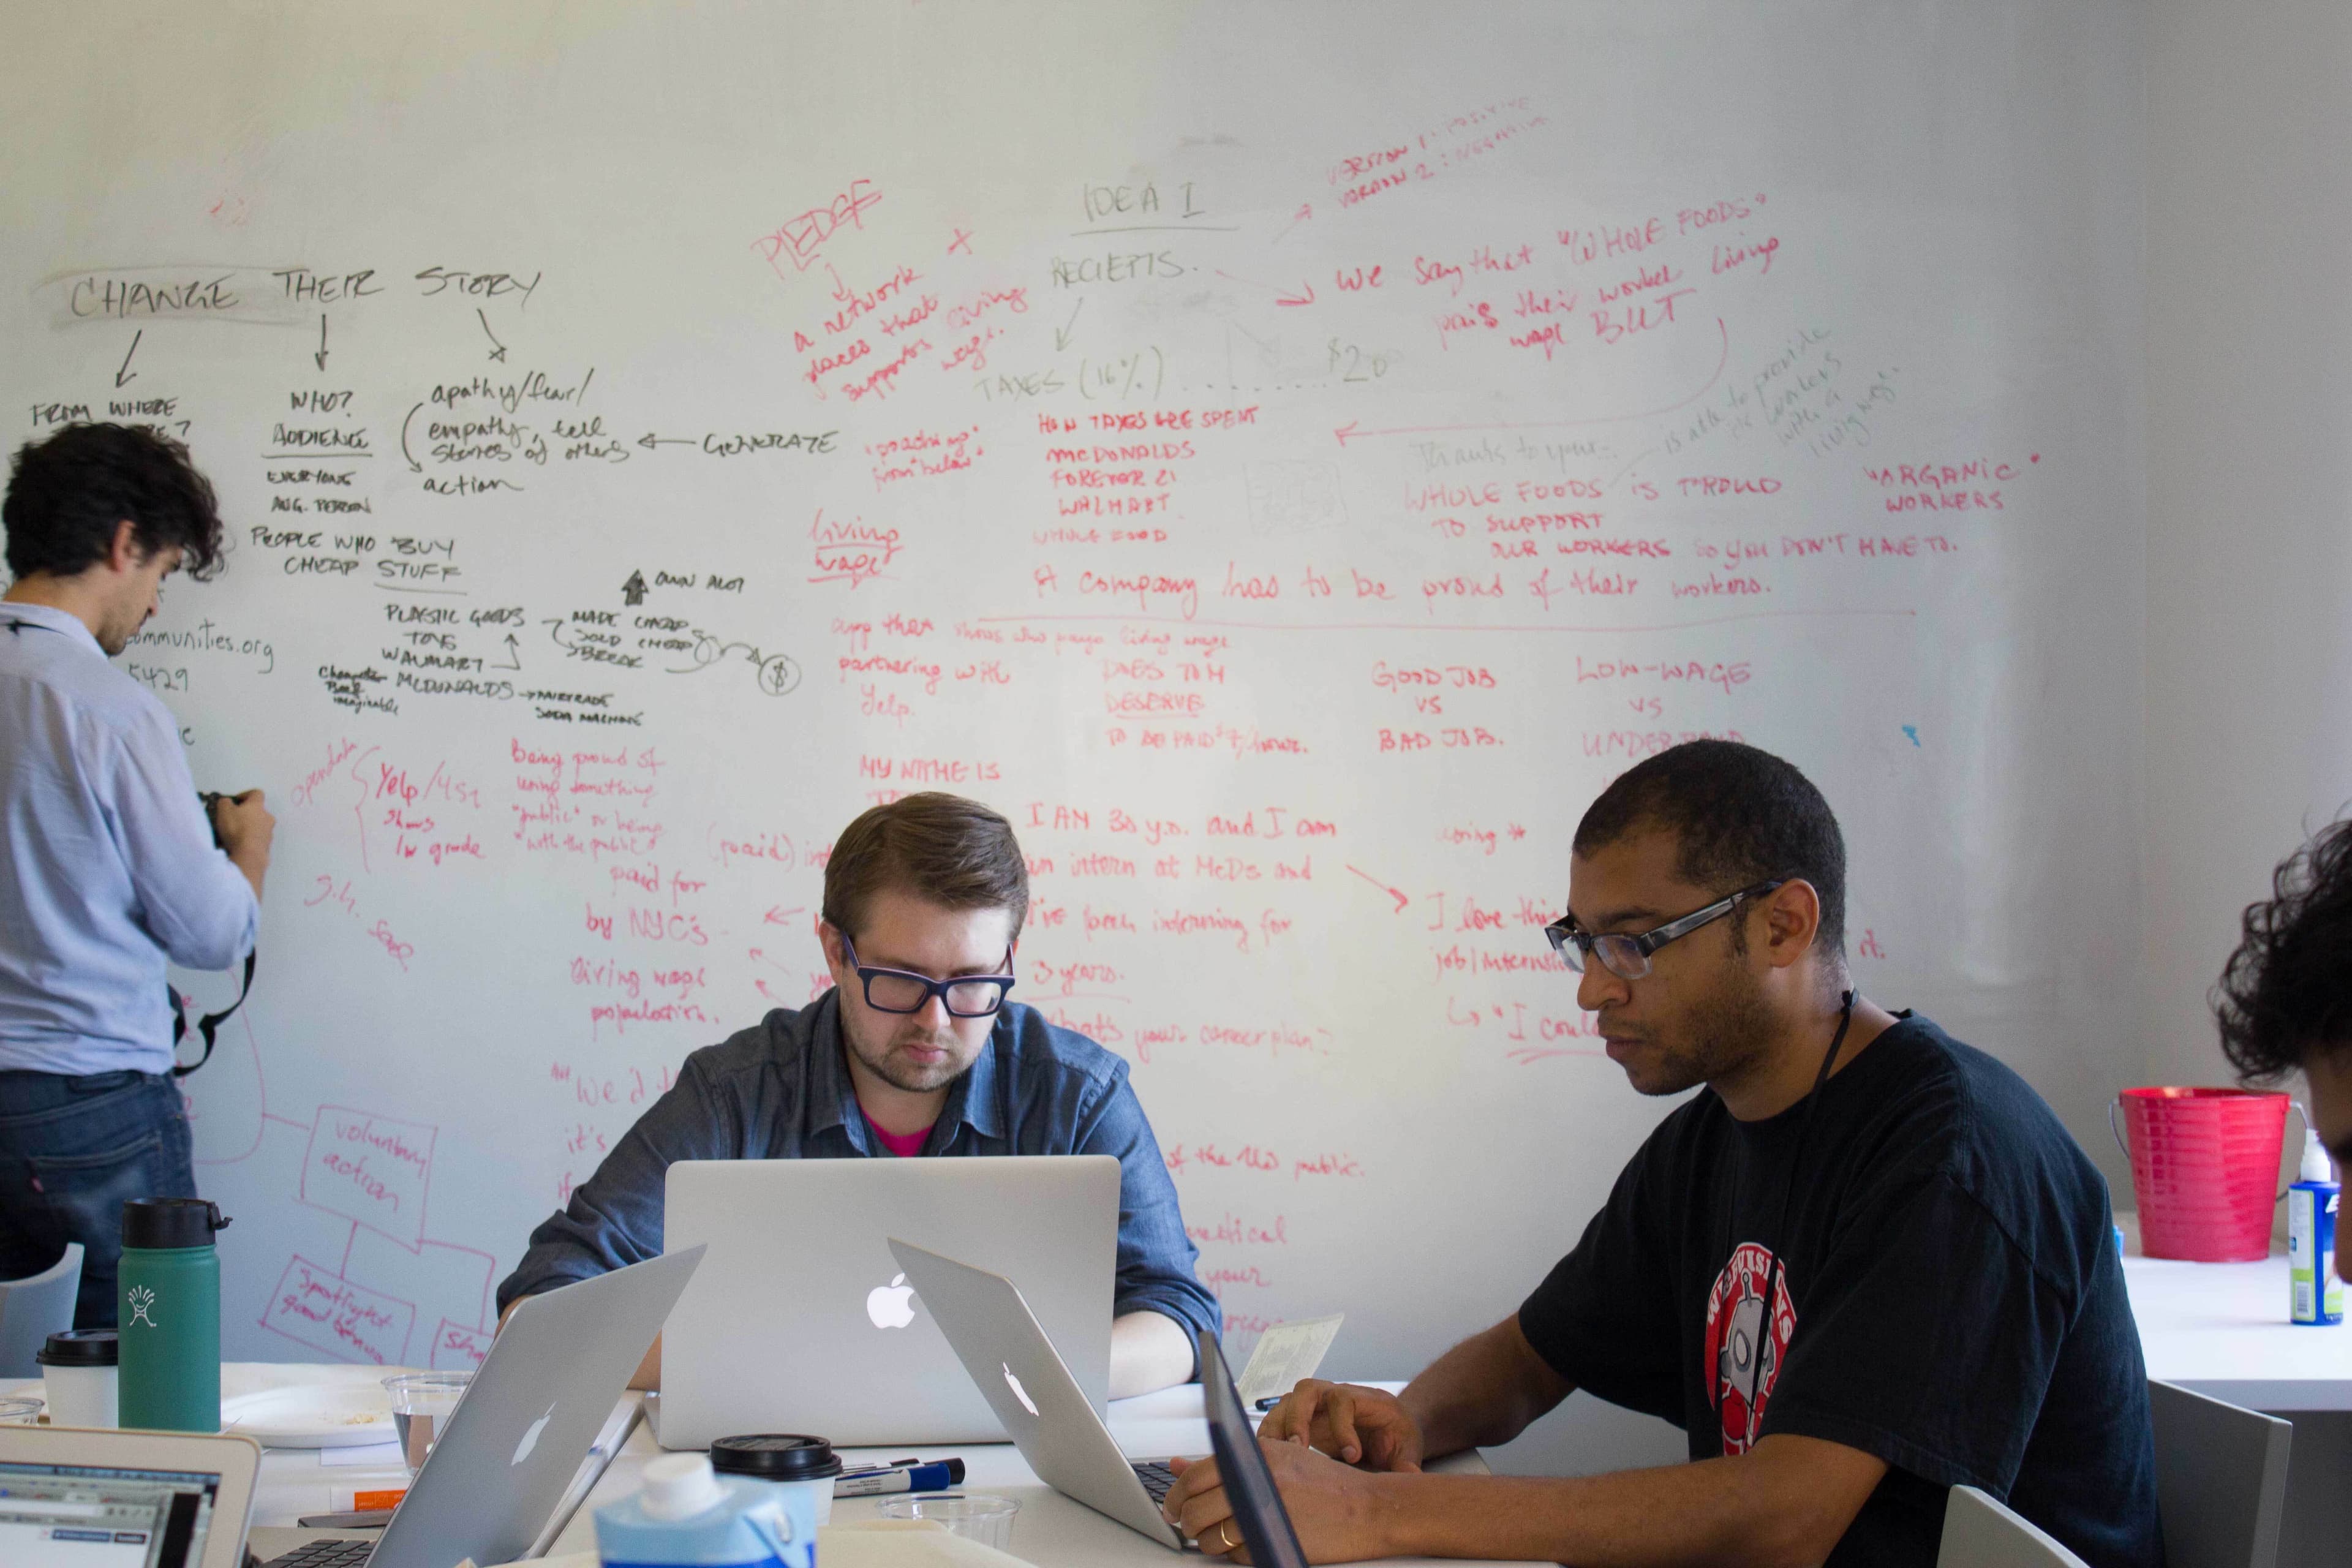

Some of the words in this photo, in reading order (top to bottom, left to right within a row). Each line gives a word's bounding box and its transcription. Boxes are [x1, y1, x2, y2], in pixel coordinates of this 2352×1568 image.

[1083, 184, 1161, 222] IDEA
[1416, 258, 1464, 296] say
[1469, 244, 1532, 273] that
[72, 273, 241, 318] CHANGE
[273, 270, 385, 303] THEIR
[416, 268, 541, 307] STORY
[824, 265, 922, 334] network
[1514, 290, 1578, 318] their
[1593, 288, 1697, 345] BUT
[973, 369, 1066, 402] TAXES
[29, 402, 92, 426] FROM
[109, 397, 179, 417] WHERE
[290, 390, 353, 418] WHO?
[552, 418, 606, 438] tell
[1039, 413, 1076, 434] HOW
[1088, 412, 1147, 434] TAXES
[1155, 410, 1193, 429] ARE
[1201, 407, 1259, 428] SPENT
[273, 423, 369, 450] AUDIENCE
[703, 431, 839, 458] GENERATE
[266, 470, 355, 486] EVERYONE
[423, 476, 524, 496] action
[313, 497, 371, 514] PERSON
[1058, 493, 1170, 516] WALMART
[1404, 480, 1501, 511] WHOLE
[1517, 478, 1603, 502] FOODS
[1886, 491, 2003, 513] WORKERS
[1431, 519, 1465, 537] TO
[1486, 512, 1605, 533] SUPPORT
[251, 526, 322, 549] PEOPLE
[334, 534, 376, 554] WHO
[391, 537, 454, 560] BUY
[1491, 540, 1538, 559] OUR
[1558, 540, 1671, 558] WORKERS
[1858, 537, 1917, 557] HAVE
[284, 556, 359, 576] CHEAP
[377, 559, 461, 582] STUFF
[1079, 572, 1198, 620] company
[1222, 561, 1280, 601] has
[1301, 566, 1330, 599] to
[1349, 569, 1396, 601] be
[1422, 571, 1504, 614] proud
[1528, 568, 1563, 612] of
[1570, 570, 1638, 599] their
[385, 603, 459, 624] PLASTIC
[469, 606, 525, 628] GOODS
[403, 631, 457, 652] TOYS
[575, 628, 621, 647] SOLD
[382, 646, 483, 673] WALMART
[839, 656, 941, 695] partnering
[956, 660, 1010, 684] with
[1372, 662, 1441, 687] GOOD
[1446, 665, 1496, 688] JOB
[1576, 657, 1753, 693] LOW-WAGE
[535, 707, 572, 722] SODA
[1106, 692, 1205, 712] DESERVE
[1379, 730, 1431, 752] BAD
[572, 747, 628, 779] proud
[859, 754, 892, 780] MY
[900, 758, 968, 783] NAME
[978, 759, 1001, 780] IS
[570, 777, 654, 807] something
[1026, 802, 1044, 828] I
[1054, 805, 1089, 831] AM
[1207, 812, 1255, 837] and
[1264, 807, 1286, 839] I
[1296, 821, 1336, 839] am
[1070, 853, 1136, 879] intern
[1153, 855, 1179, 880] at
[1274, 855, 1312, 881] and
[611, 861, 659, 895] paid
[671, 871, 706, 906] for
[586, 903, 612, 941] by
[1455, 896, 1506, 931] love
[1261, 909, 1292, 948] for
[334, 1119, 428, 1180] voluntary
[323, 1152, 399, 1213] action
